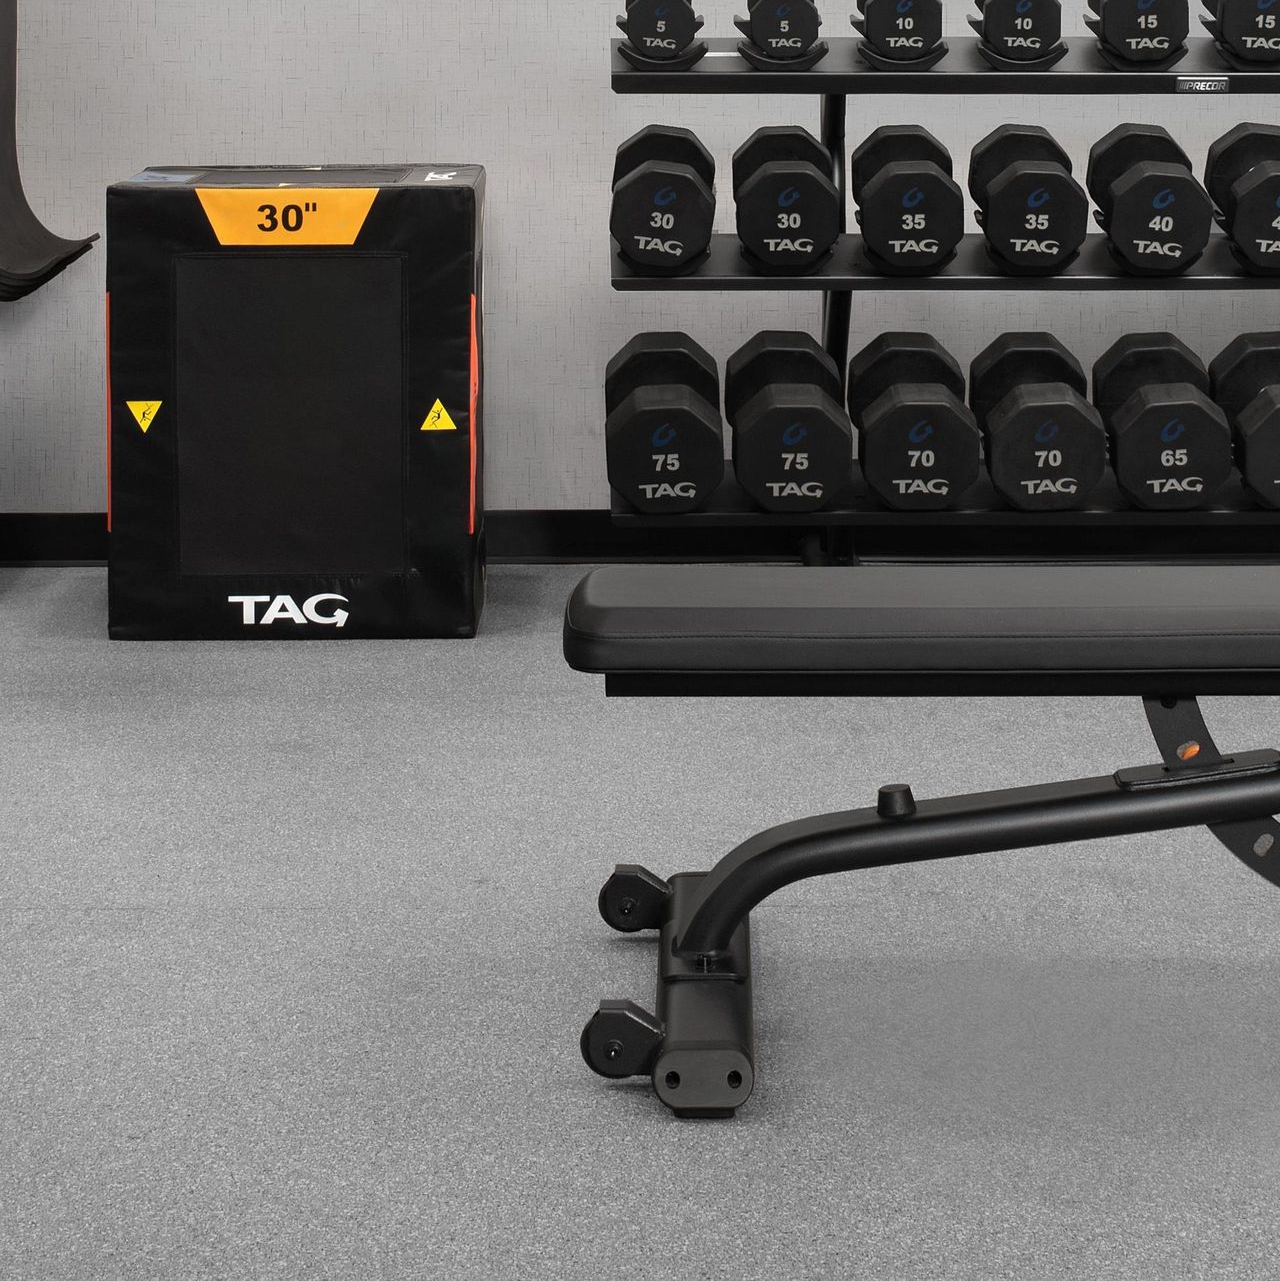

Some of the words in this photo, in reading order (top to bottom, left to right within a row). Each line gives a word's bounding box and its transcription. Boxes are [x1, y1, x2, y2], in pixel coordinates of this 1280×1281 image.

[656, 20, 666, 33] 5
[779, 20, 790, 33] 5
[895, 17, 914, 30] 10
[1014, 17, 1033, 30] 10
[1137, 14, 1158, 29] 15
[1255, 14, 1276, 29] 15
[642, 37, 677, 50] TAG
[767, 37, 802, 48] TAG
[885, 36, 924, 48] TAG
[1003, 36, 1041, 49] TAG
[1125, 36, 1170, 50] TAG
[1186, 81, 1226, 91] PRECOR
[256, 202, 318, 233] 30"
[649, 211, 675, 230] 30
[777, 212, 802, 229] 30
[901, 213, 926, 230] 35
[1024, 213, 1049, 230] 35
[1148, 215, 1174, 232] 40
[633, 235, 684, 257] TAG
[763, 238, 814, 253] TAG
[888, 238, 939, 254] TAG
[1009, 238, 1060, 255] TAG
[1132, 239, 1183, 258] TAG
[651, 453, 680, 472] 75
[781, 452, 809, 470] 75
[907, 449, 935, 468] 70
[1034, 449, 1062, 468] 70
[1160, 448, 1188, 467] 65
[638, 481, 697, 499] TAG
[765, 481, 824, 498] TAG
[892, 478, 949, 496] TAG
[1020, 477, 1078, 495] TAG
[1146, 476, 1204, 494] TAG
[227, 592, 350, 628] TAG
